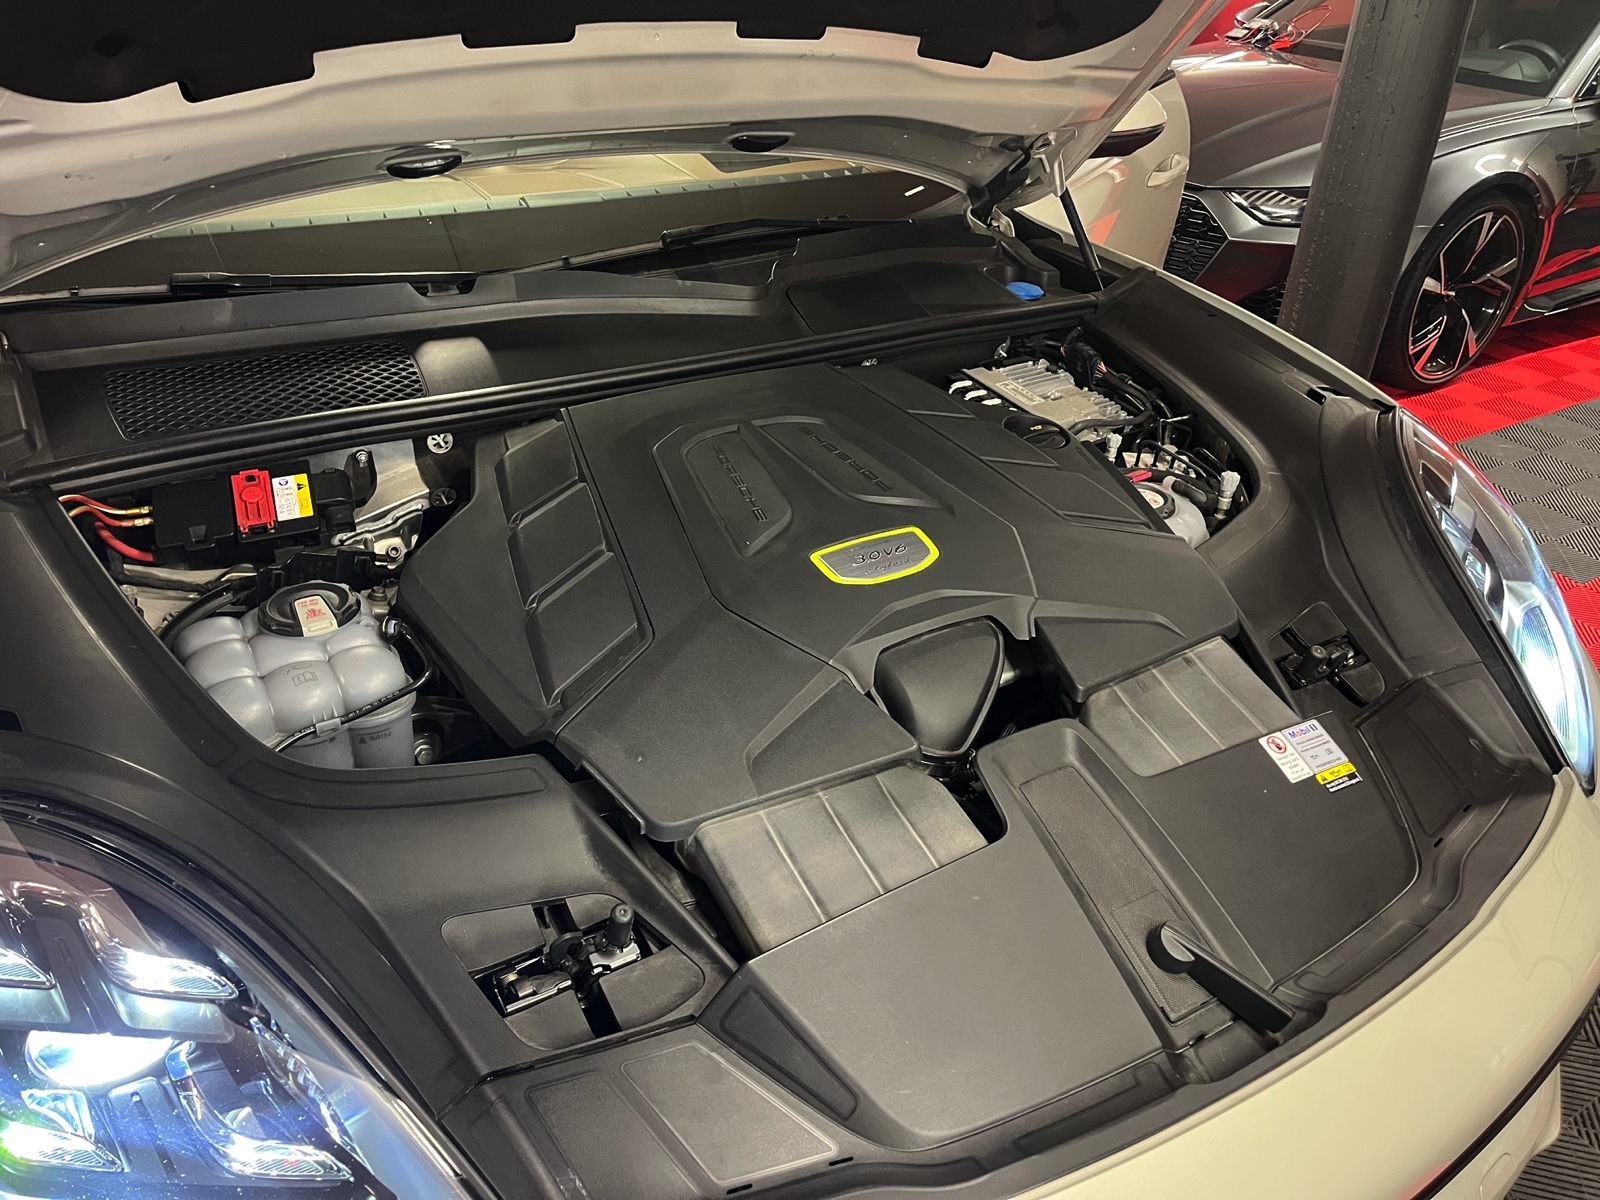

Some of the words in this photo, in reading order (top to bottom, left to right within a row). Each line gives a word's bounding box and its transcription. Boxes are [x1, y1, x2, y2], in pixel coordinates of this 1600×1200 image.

[798, 426, 892, 491] PORSCHE
[712, 444, 769, 522] PORSCHE
[371, 731, 391, 741] MIN
[1288, 728, 1310, 739] Mobil
